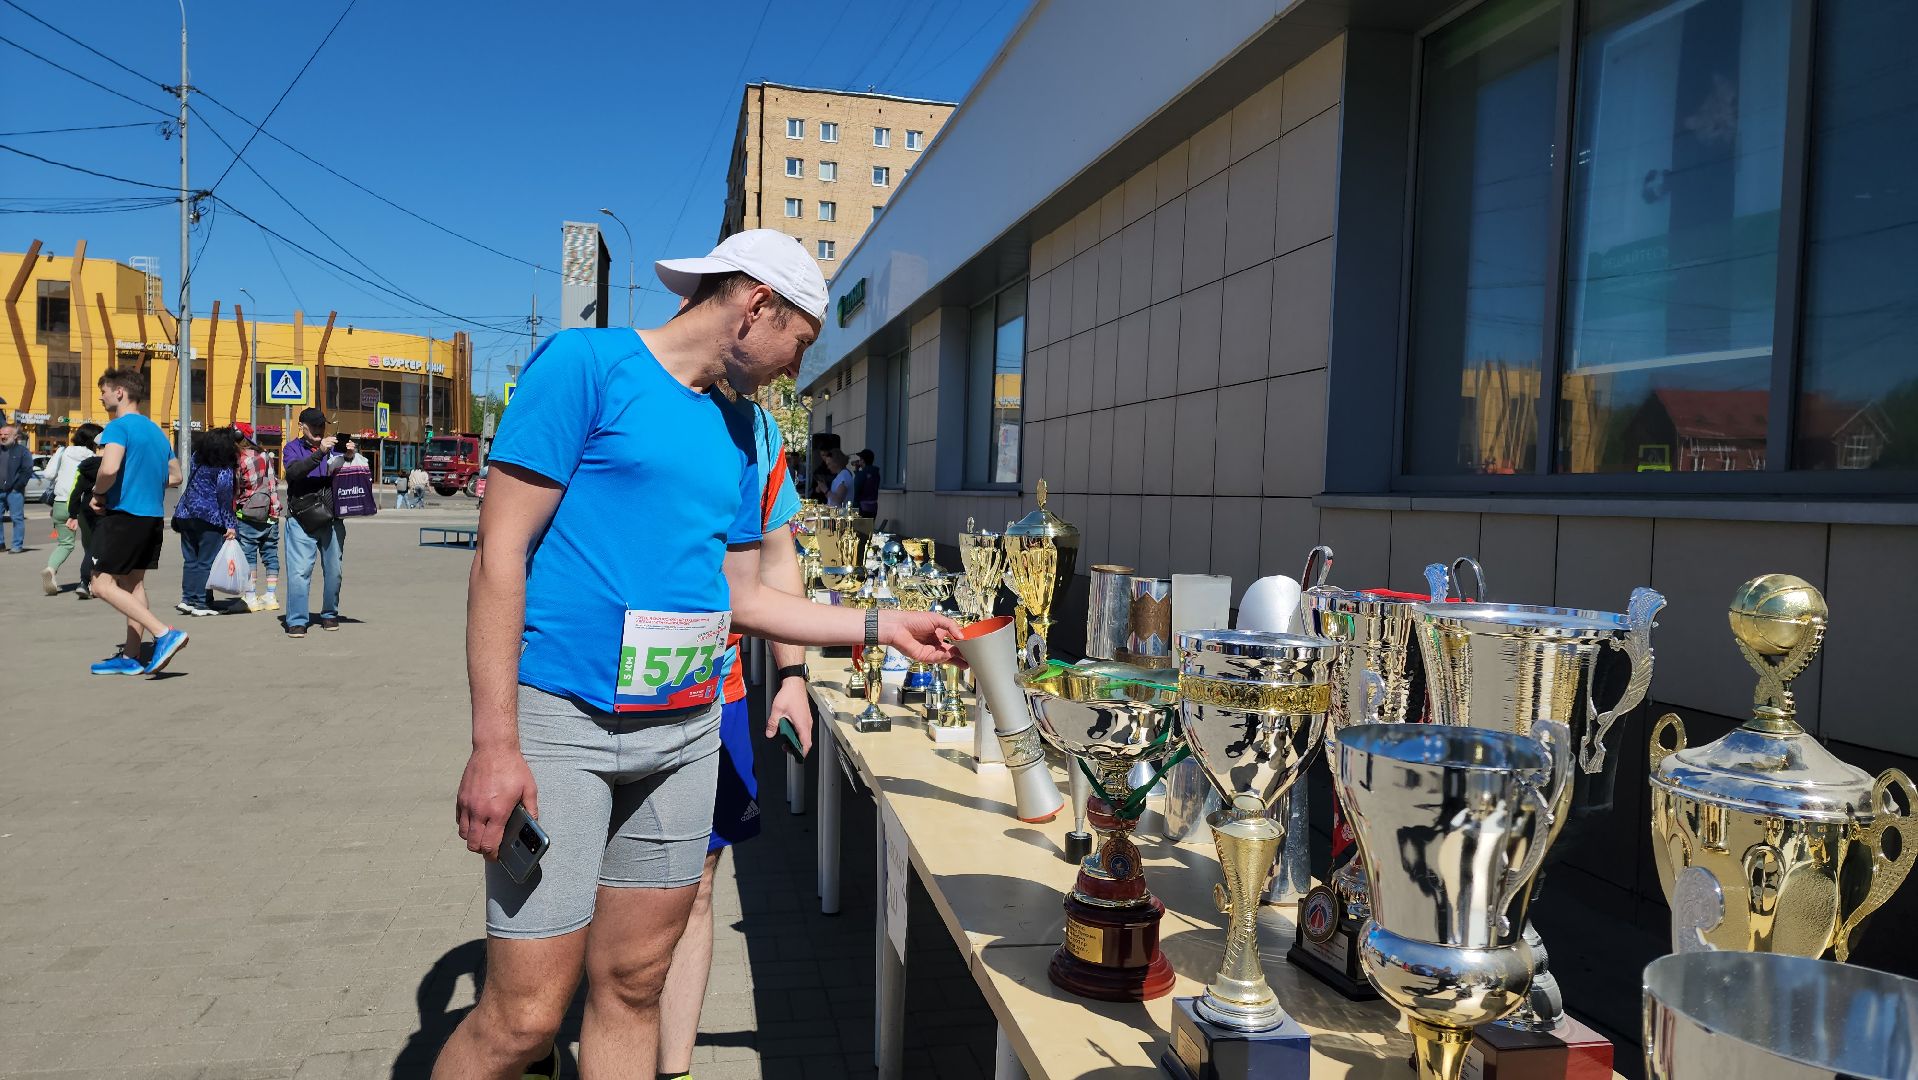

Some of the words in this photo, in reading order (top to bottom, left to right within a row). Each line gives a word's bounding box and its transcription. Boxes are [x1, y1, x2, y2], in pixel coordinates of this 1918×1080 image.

[383, 357, 421, 370] БУРГЕР
[338, 486, 365, 496] familia
[643, 646, 716, 687] 573
